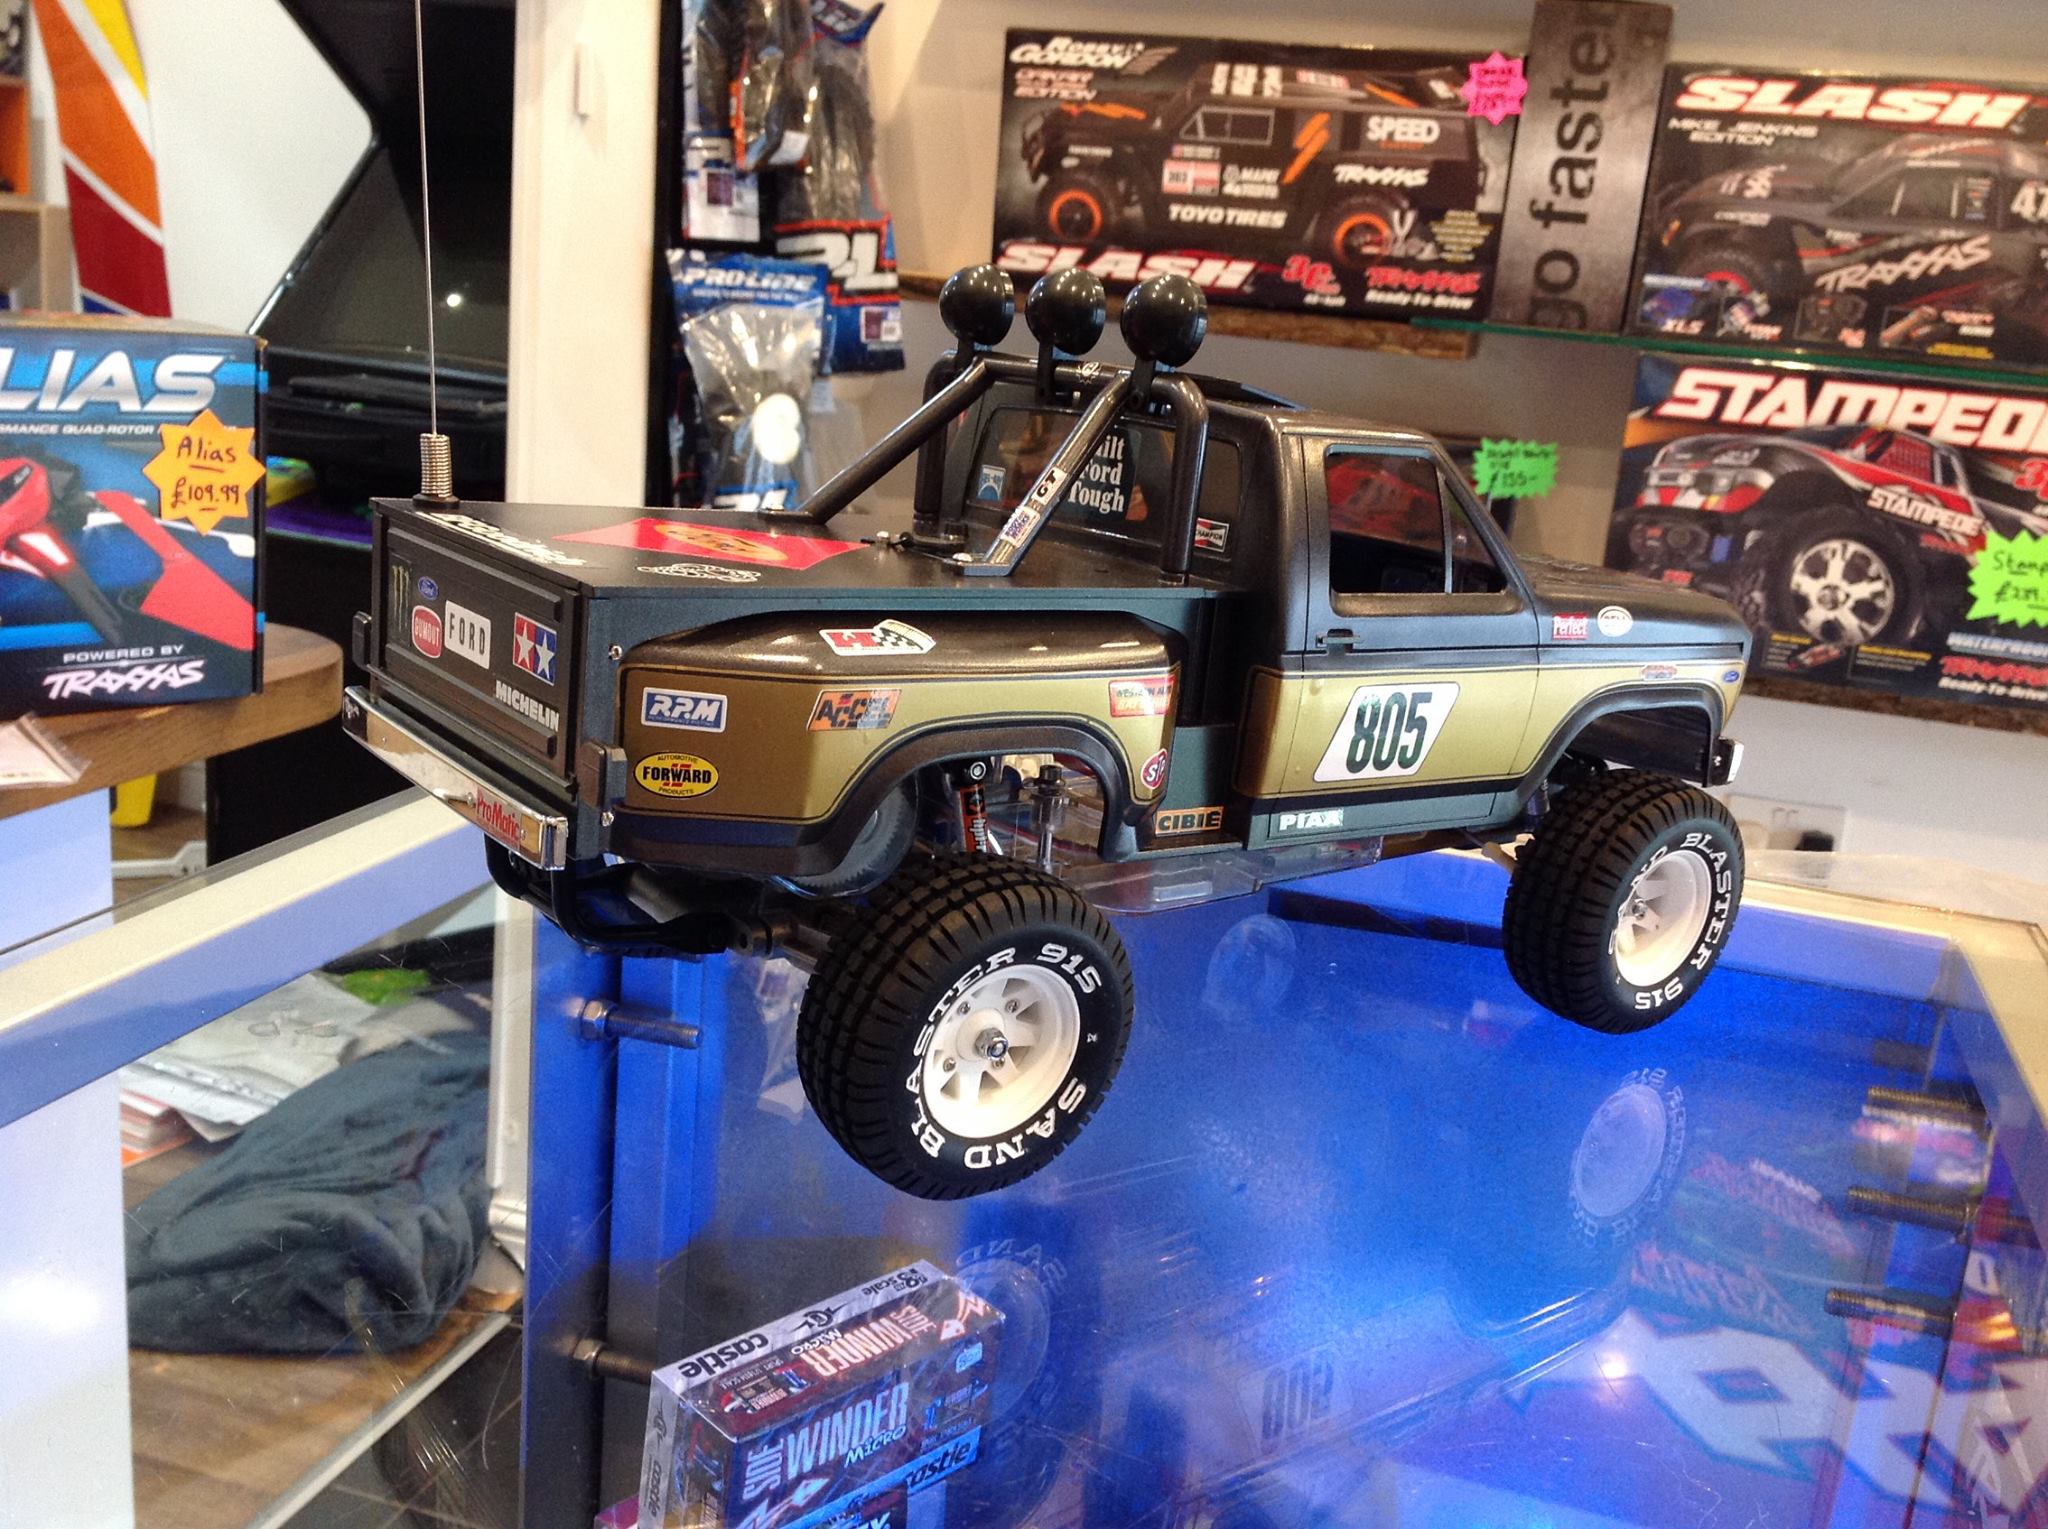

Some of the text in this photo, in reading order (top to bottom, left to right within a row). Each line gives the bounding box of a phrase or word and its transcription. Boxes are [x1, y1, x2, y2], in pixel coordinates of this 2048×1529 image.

[1676, 77, 2031, 128] SLASH
[1366, 116, 1441, 144] SPEED
[1668, 117, 1818, 138] MIKE JENKINS
[1689, 131, 1774, 147] EDITION
[1333, 164, 1430, 187] TRAXXAS
[1169, 203, 1288, 229] TOYO TIRES
[997, 243, 1257, 289] SLASH
[1815, 233, 1992, 293] TRAXXAS
[176, 435, 237, 464] Alias
[1095, 434, 1126, 460] ilt
[171, 476, 240, 509] £109.99
[1036, 469, 1057, 498] GT
[1866, 486, 1985, 537] STAMPEDE
[415, 616, 440, 647] GUMOUT
[449, 612, 486, 655] FORD
[1553, 614, 1588, 635] Perfect
[63, 645, 183, 664] POWERED BY
[43, 660, 205, 699] TRAXXAS
[495, 680, 559, 732] MICHELIN
[1346, 692, 1434, 773] 805
[643, 766, 712, 784] FORWARD
[657, 754, 699, 764] AUTOMOTIVE
[658, 787, 694, 795] PRODUCTS
[476, 788, 520, 841] ProMatic
[1279, 809, 1343, 830] PIAA
[1680, 833, 1733, 970] BLASTER
[1634, 976, 1684, 1010] 915
[905, 942, 1102, 1169] SAND BLASTER 915
[678, 1333, 770, 1379] castle
[800, 1316, 913, 1377] WINDER
[786, 1381, 909, 1480] WINDER
[742, 1437, 785, 1500] SIDE
